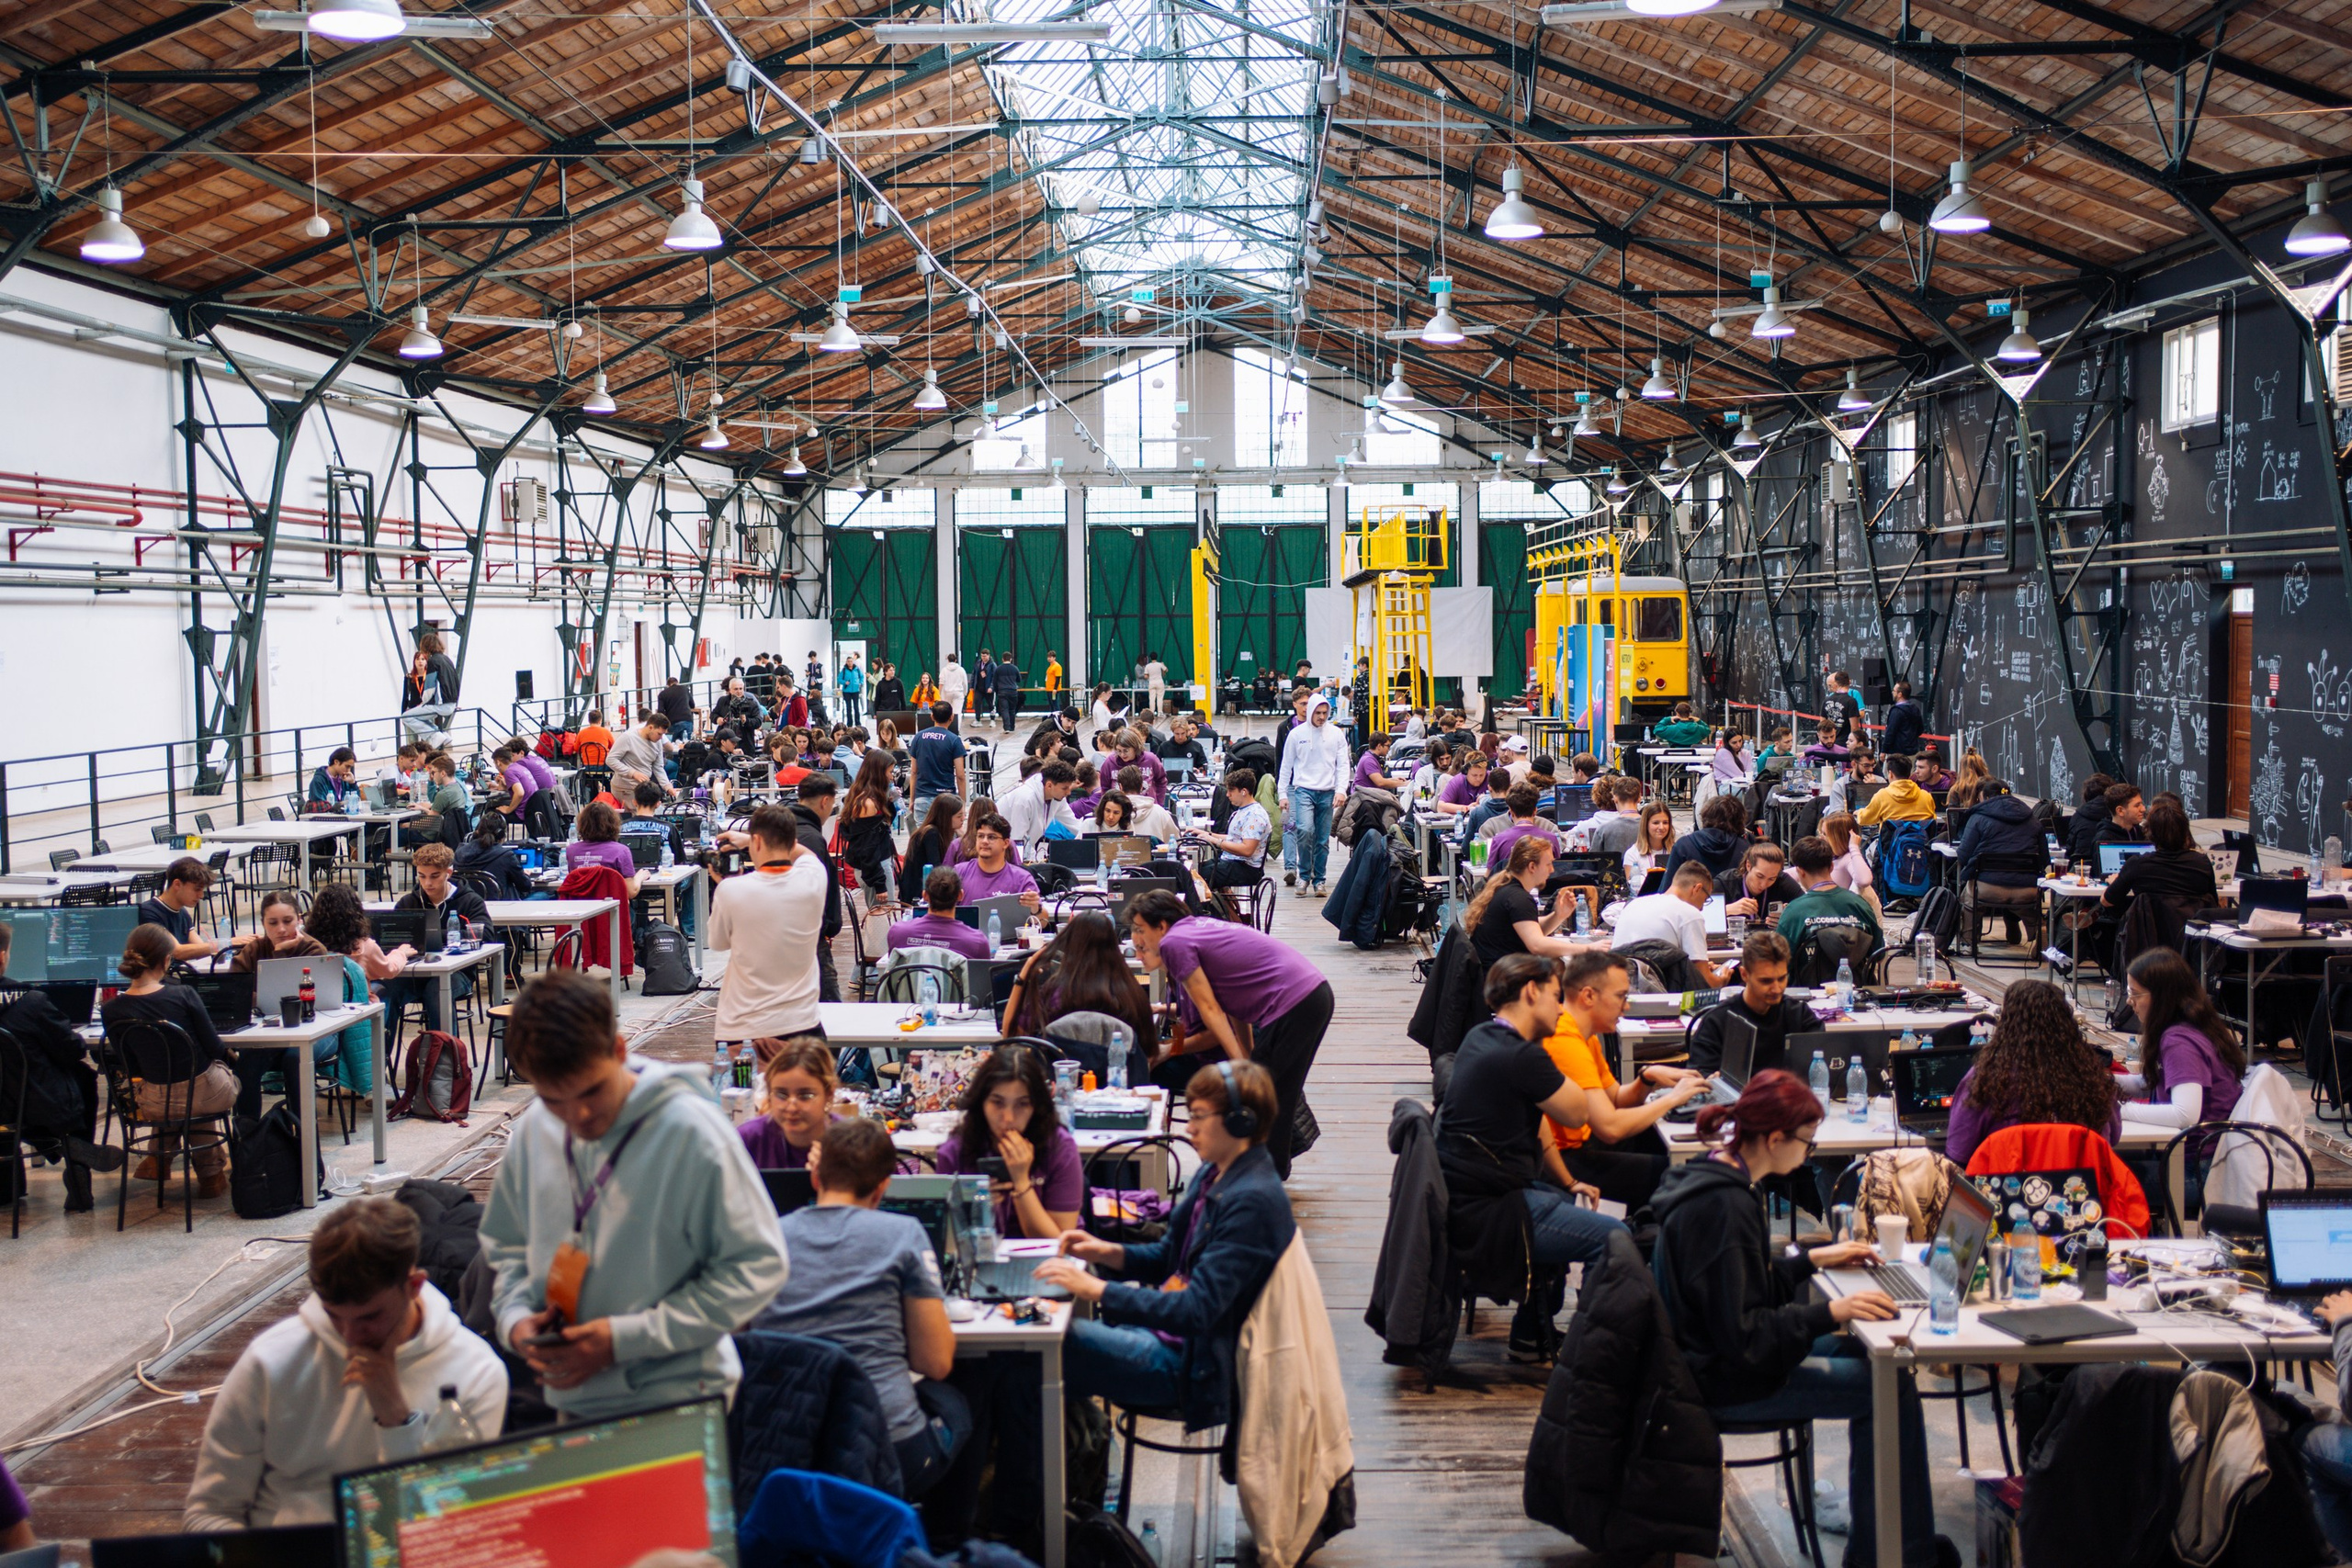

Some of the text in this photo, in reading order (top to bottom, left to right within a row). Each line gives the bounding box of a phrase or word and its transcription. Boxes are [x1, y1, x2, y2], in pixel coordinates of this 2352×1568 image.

[922, 731, 946, 740] UPRETY
[1804, 917, 1839, 926] Success
[1840, 914, 1860, 924] calls.
